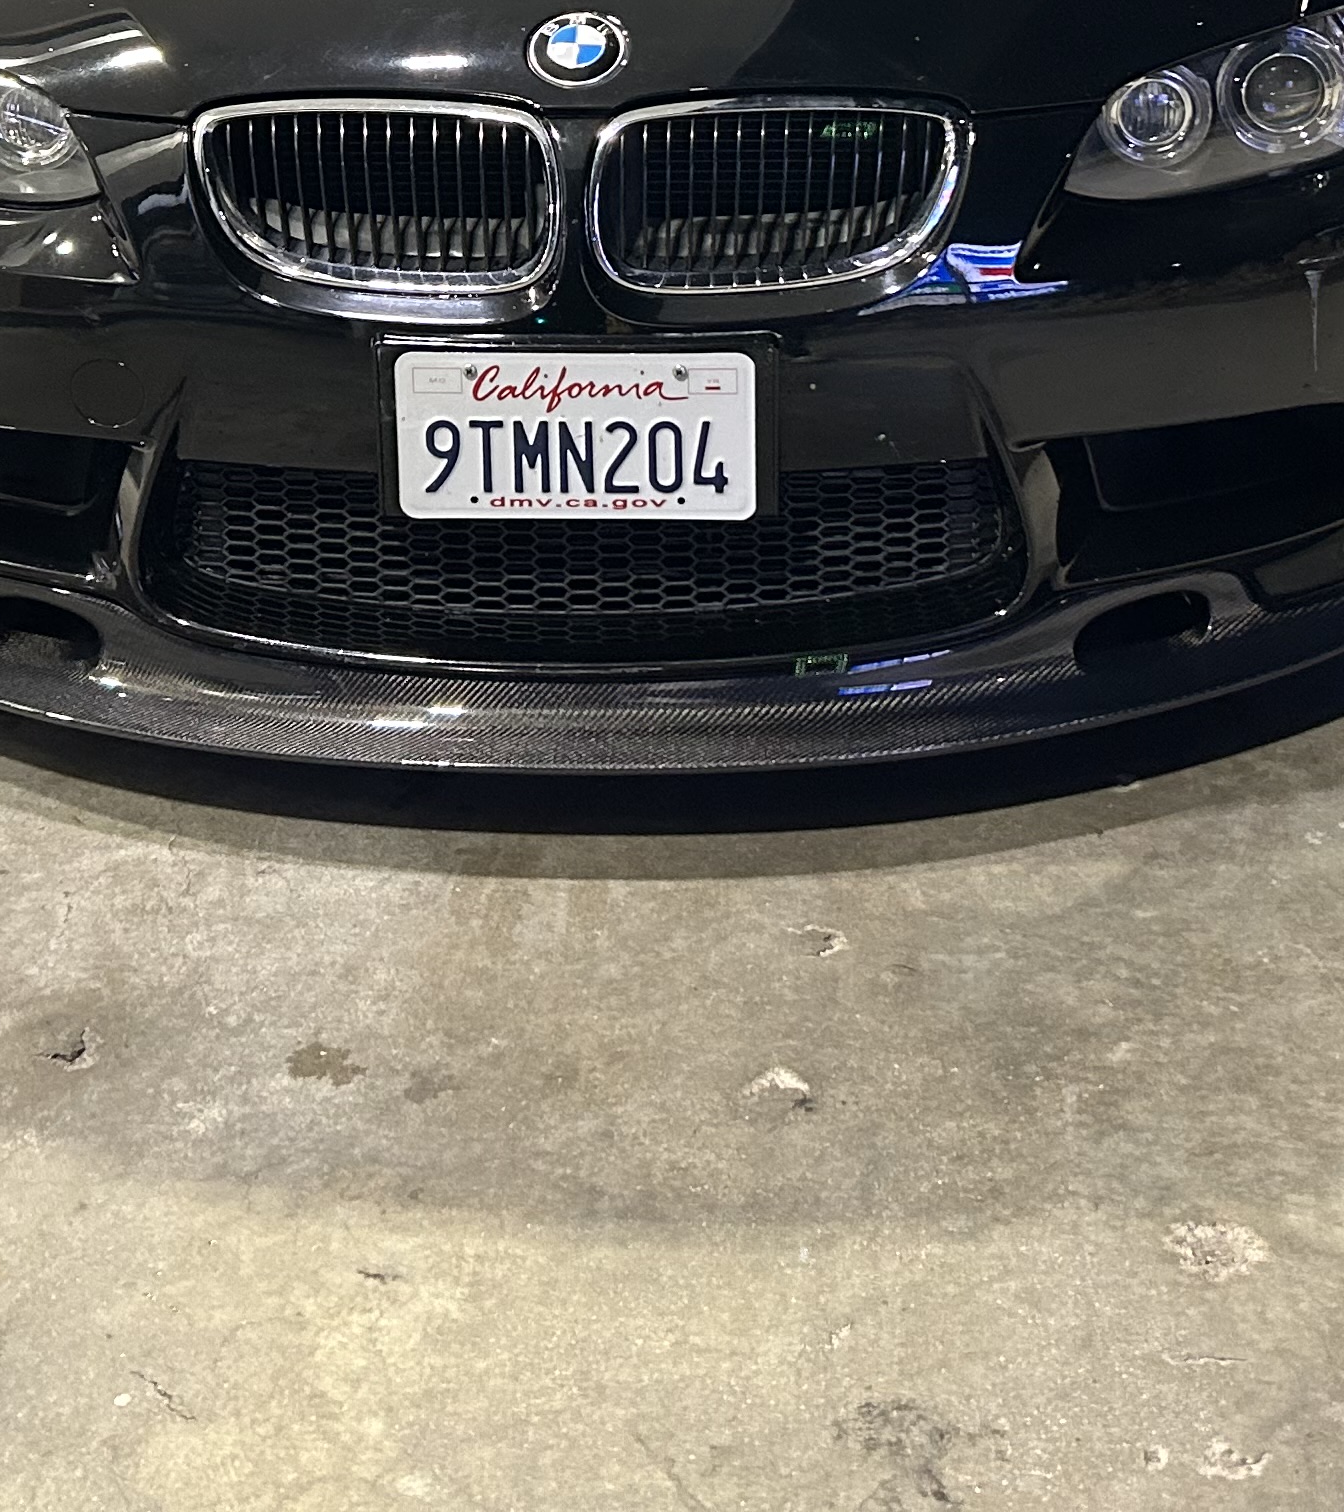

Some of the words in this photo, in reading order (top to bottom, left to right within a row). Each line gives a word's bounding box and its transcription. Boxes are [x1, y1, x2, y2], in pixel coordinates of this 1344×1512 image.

[472, 365, 689, 413] California
[425, 420, 729, 494] 9TMN204
[489, 496, 668, 511] dmv.ca.gov
